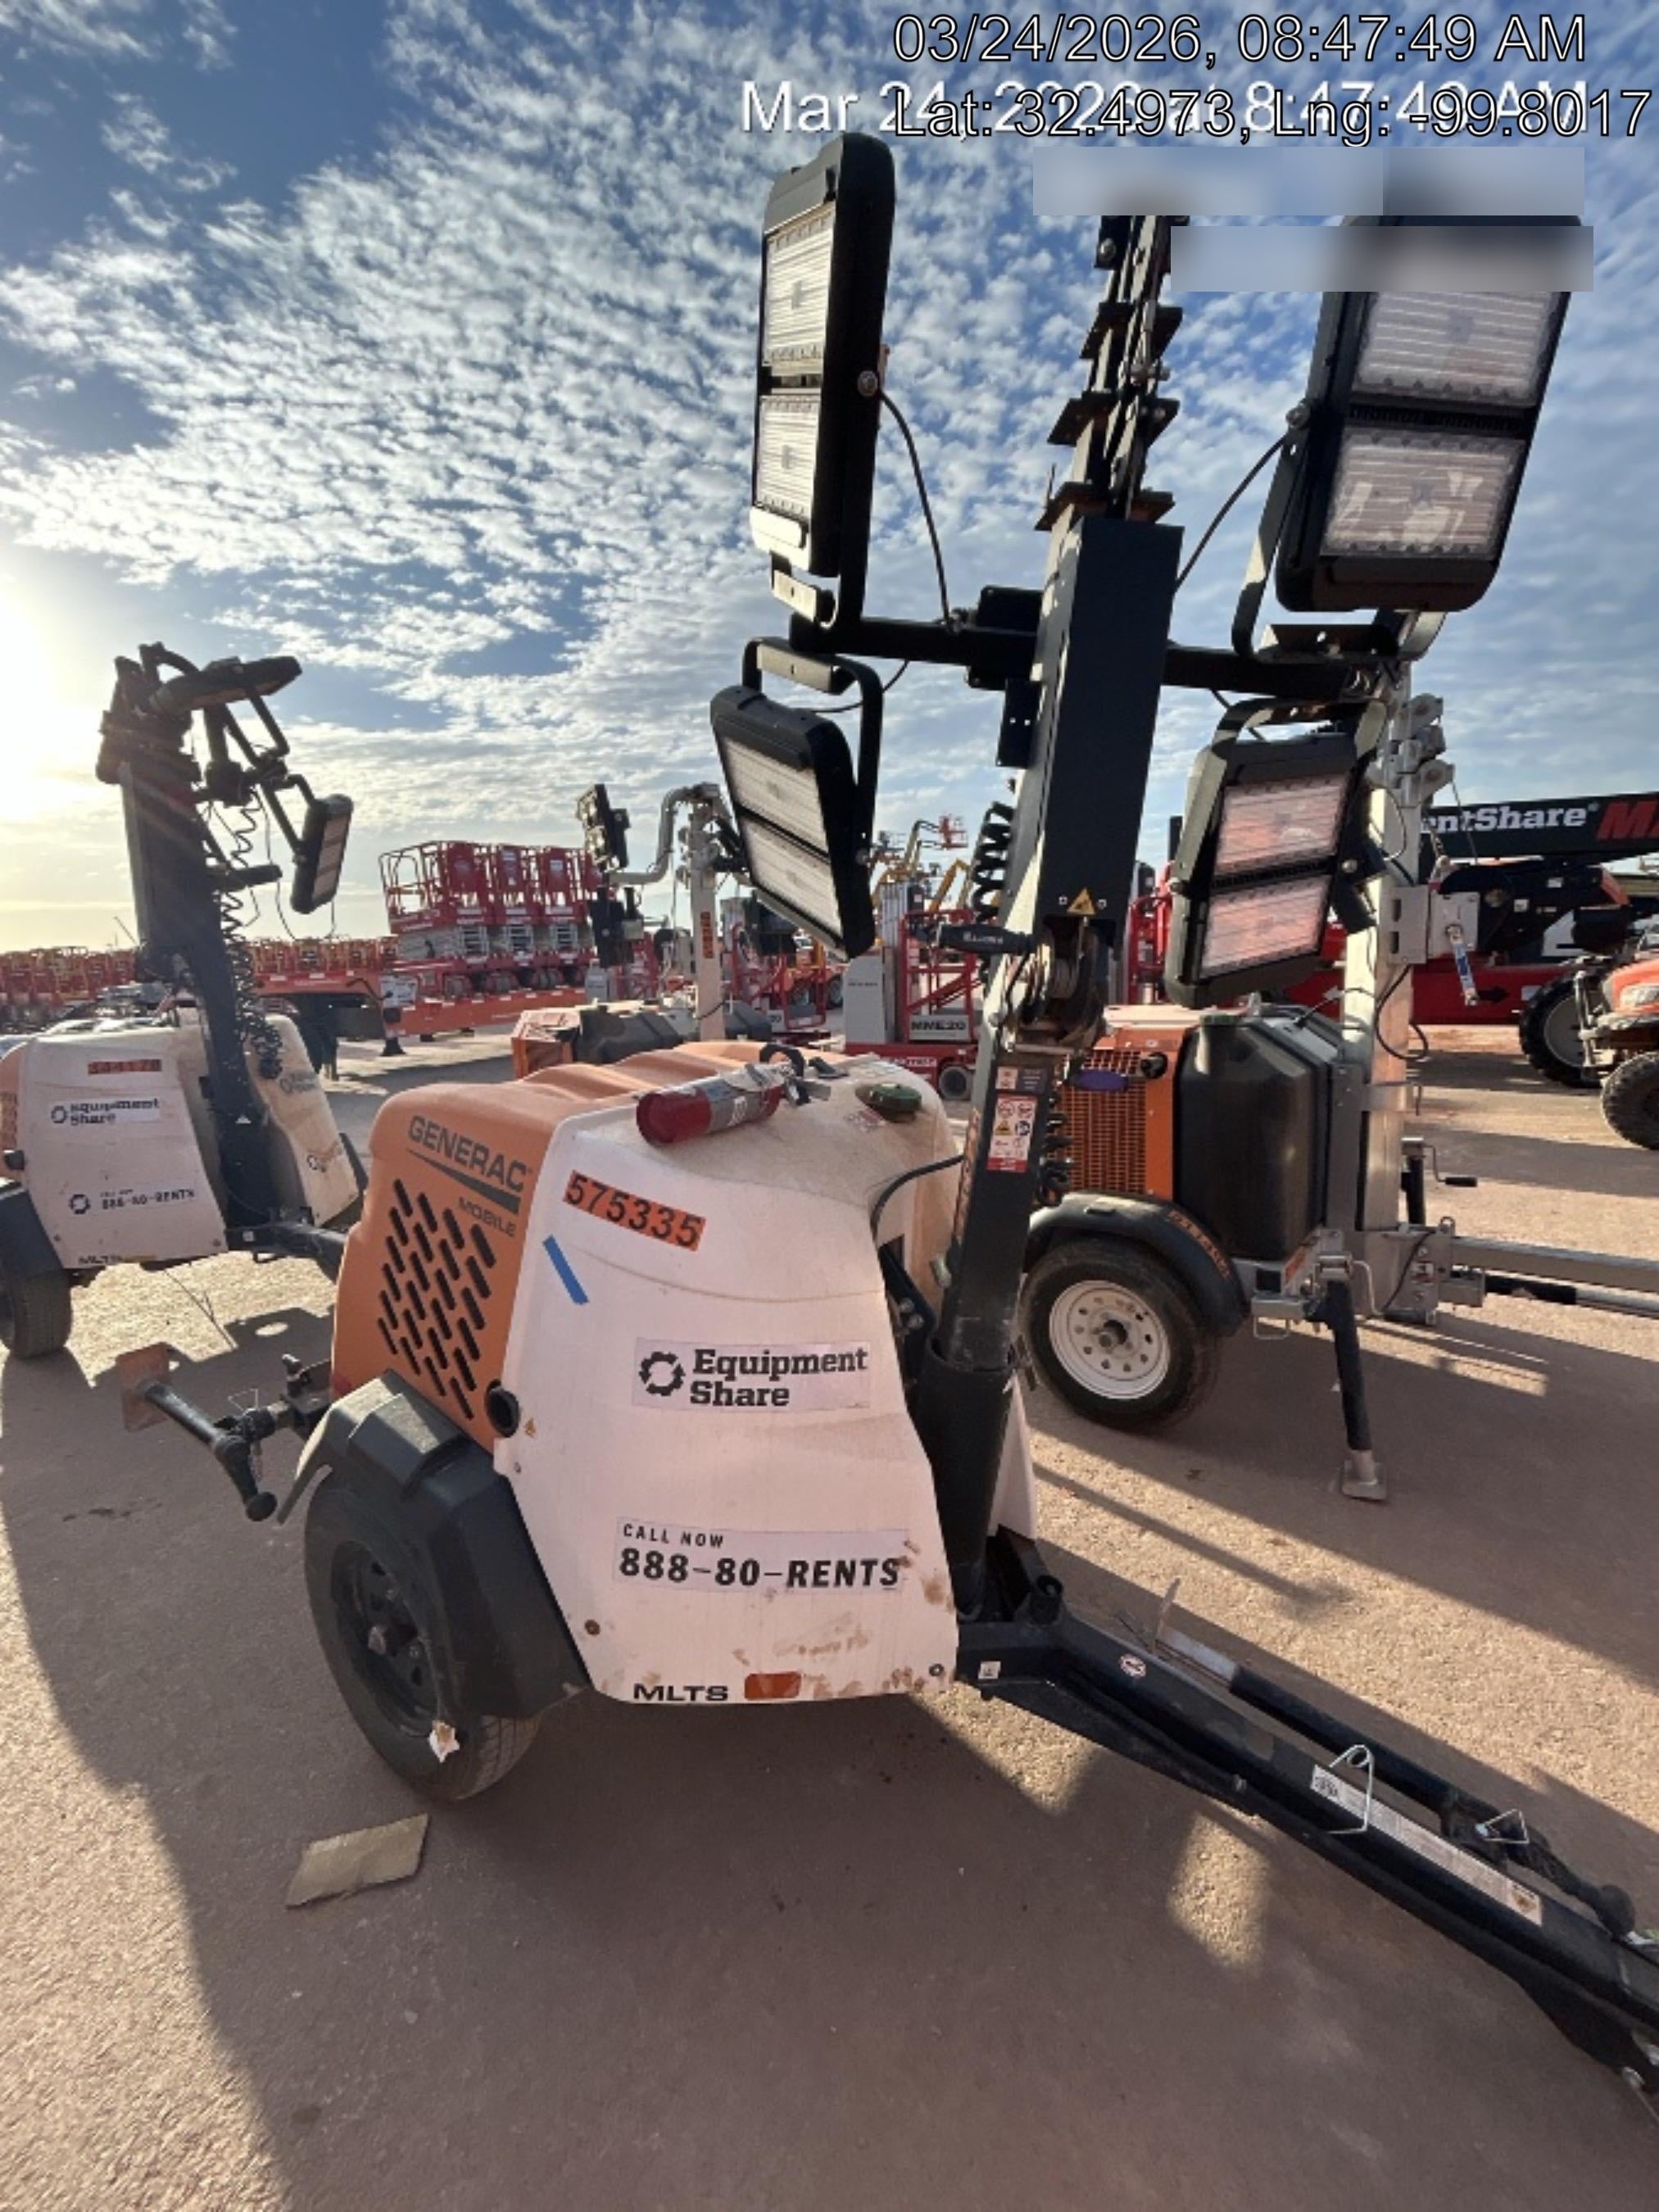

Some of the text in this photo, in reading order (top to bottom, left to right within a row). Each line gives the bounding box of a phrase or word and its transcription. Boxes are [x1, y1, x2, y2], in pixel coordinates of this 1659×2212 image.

[1595, 800, 1659, 841] M
[407, 1115, 527, 1193] GENERAC
[458, 1196, 516, 1237] MOBILE
[566, 1173, 703, 1247] 575335
[692, 1348, 868, 1381] Equipment
[689, 1380, 791, 1407] Share
[623, 1523, 724, 1549] CALL NOW
[619, 1547, 900, 1589] 888-80-RENTS
[633, 1682, 729, 1702] MLTS
